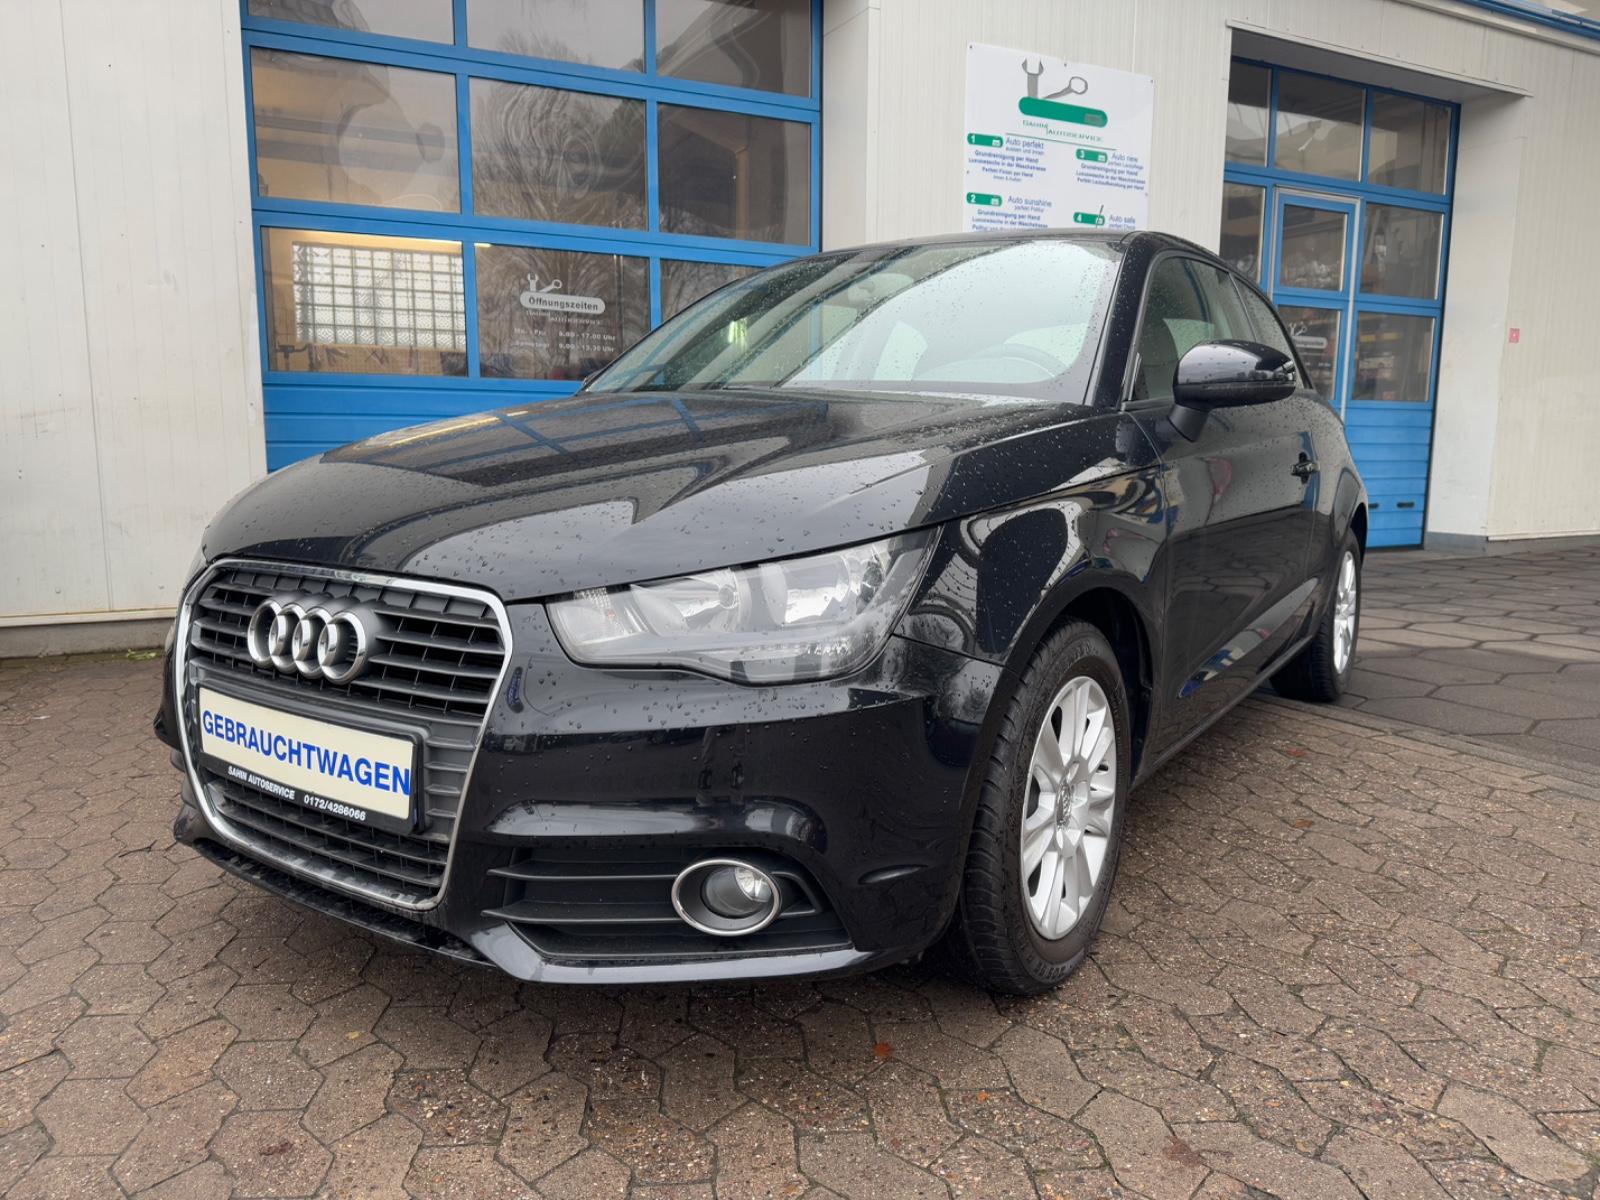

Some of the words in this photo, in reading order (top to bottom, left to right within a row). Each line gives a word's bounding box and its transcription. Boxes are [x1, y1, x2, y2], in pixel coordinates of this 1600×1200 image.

[970, 134, 976, 143] 1
[1006, 137, 1021, 145] Auto
[1023, 140, 1044, 150] perfekt
[1080, 150, 1085, 159] 3
[1112, 153, 1126, 161] Auto
[970, 194, 976, 203] 2
[1008, 196, 1023, 204] Auto
[1077, 213, 1082, 222] 4
[528, 296, 598, 311] Öffnungszeiten
[202, 710, 410, 796] GEBRAUCHTWAGEN
[227, 765, 247, 782] SAHIN
[248, 774, 295, 801] AUTOSERVICE
[304, 794, 366, 822] 0172/4286066
